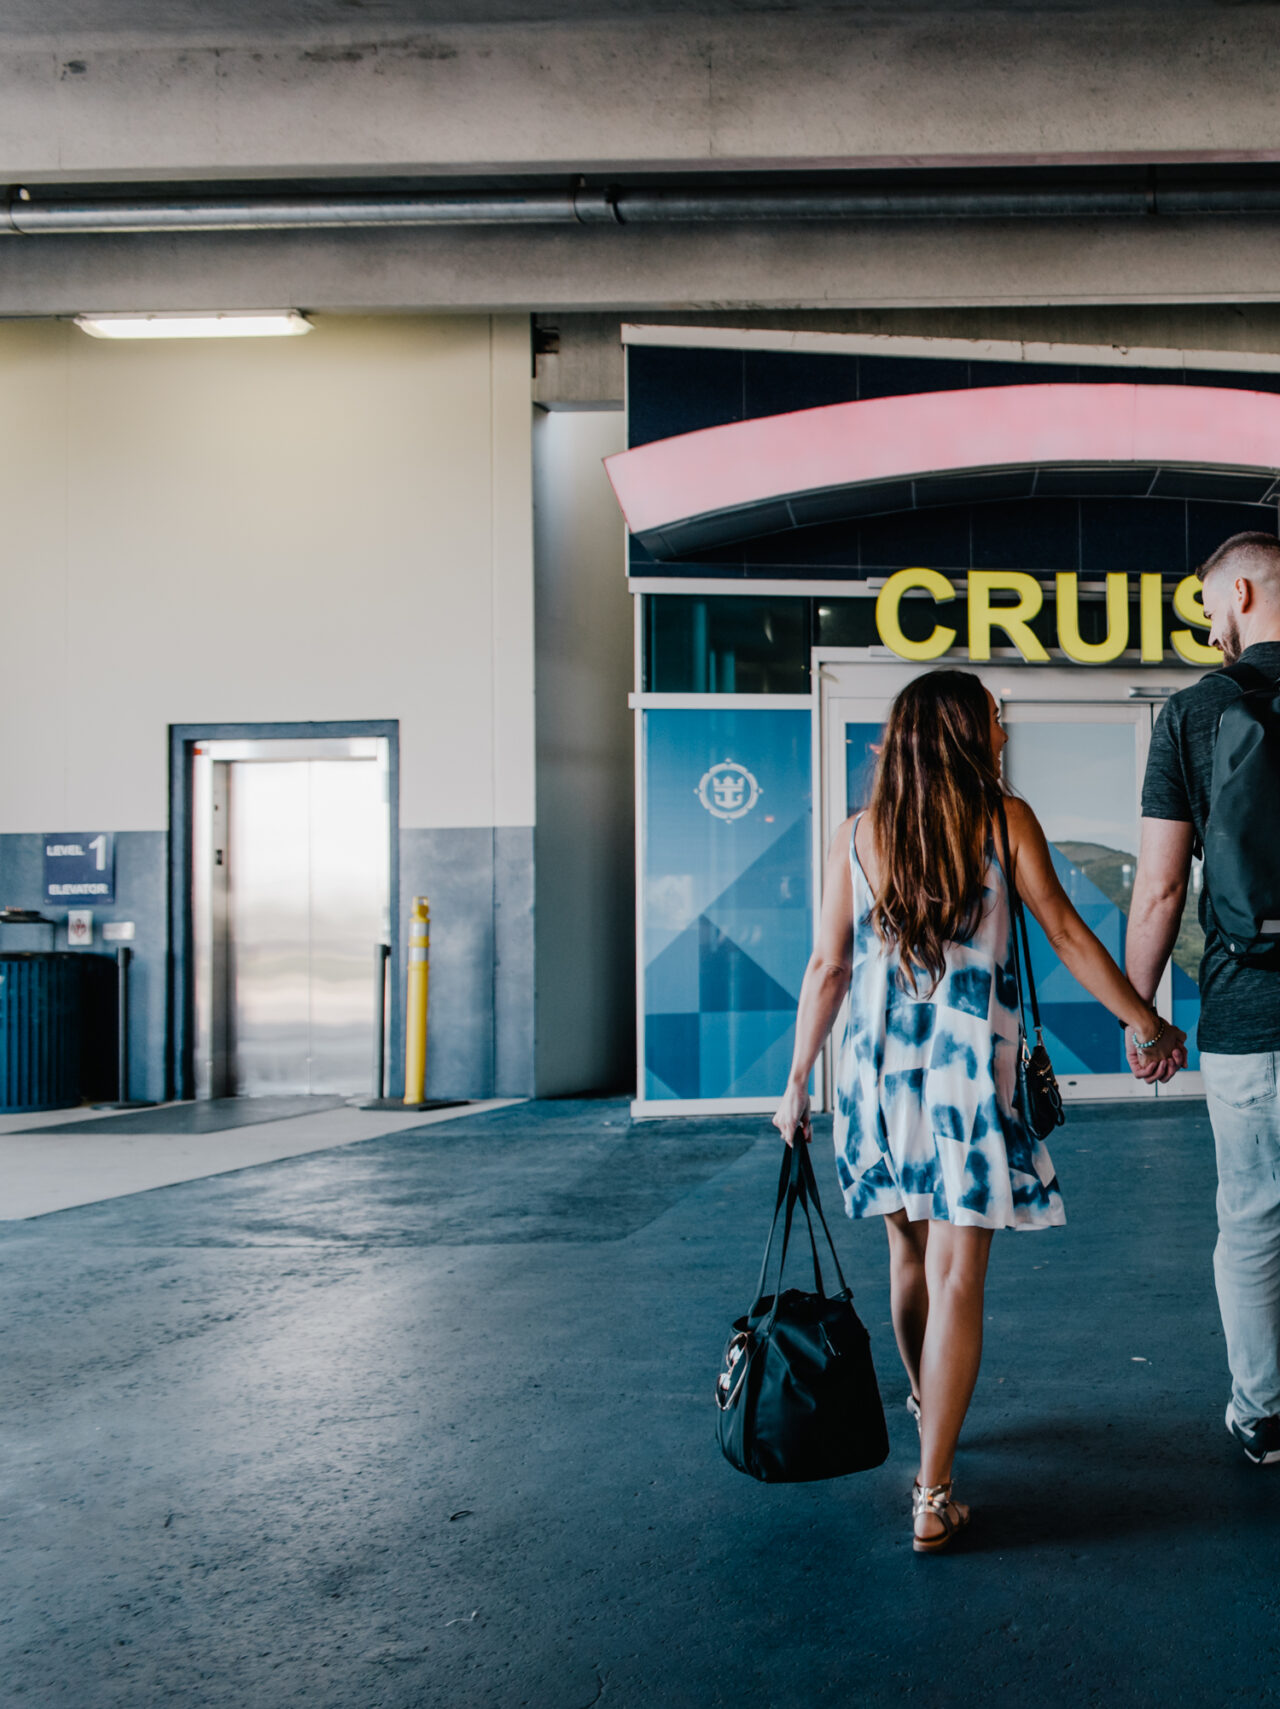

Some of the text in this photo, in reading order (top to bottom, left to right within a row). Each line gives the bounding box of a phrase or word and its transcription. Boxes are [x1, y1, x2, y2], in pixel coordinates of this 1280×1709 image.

[46, 834, 106, 871] LEVEL 1
[48, 883, 109, 895] ELEVATOR
